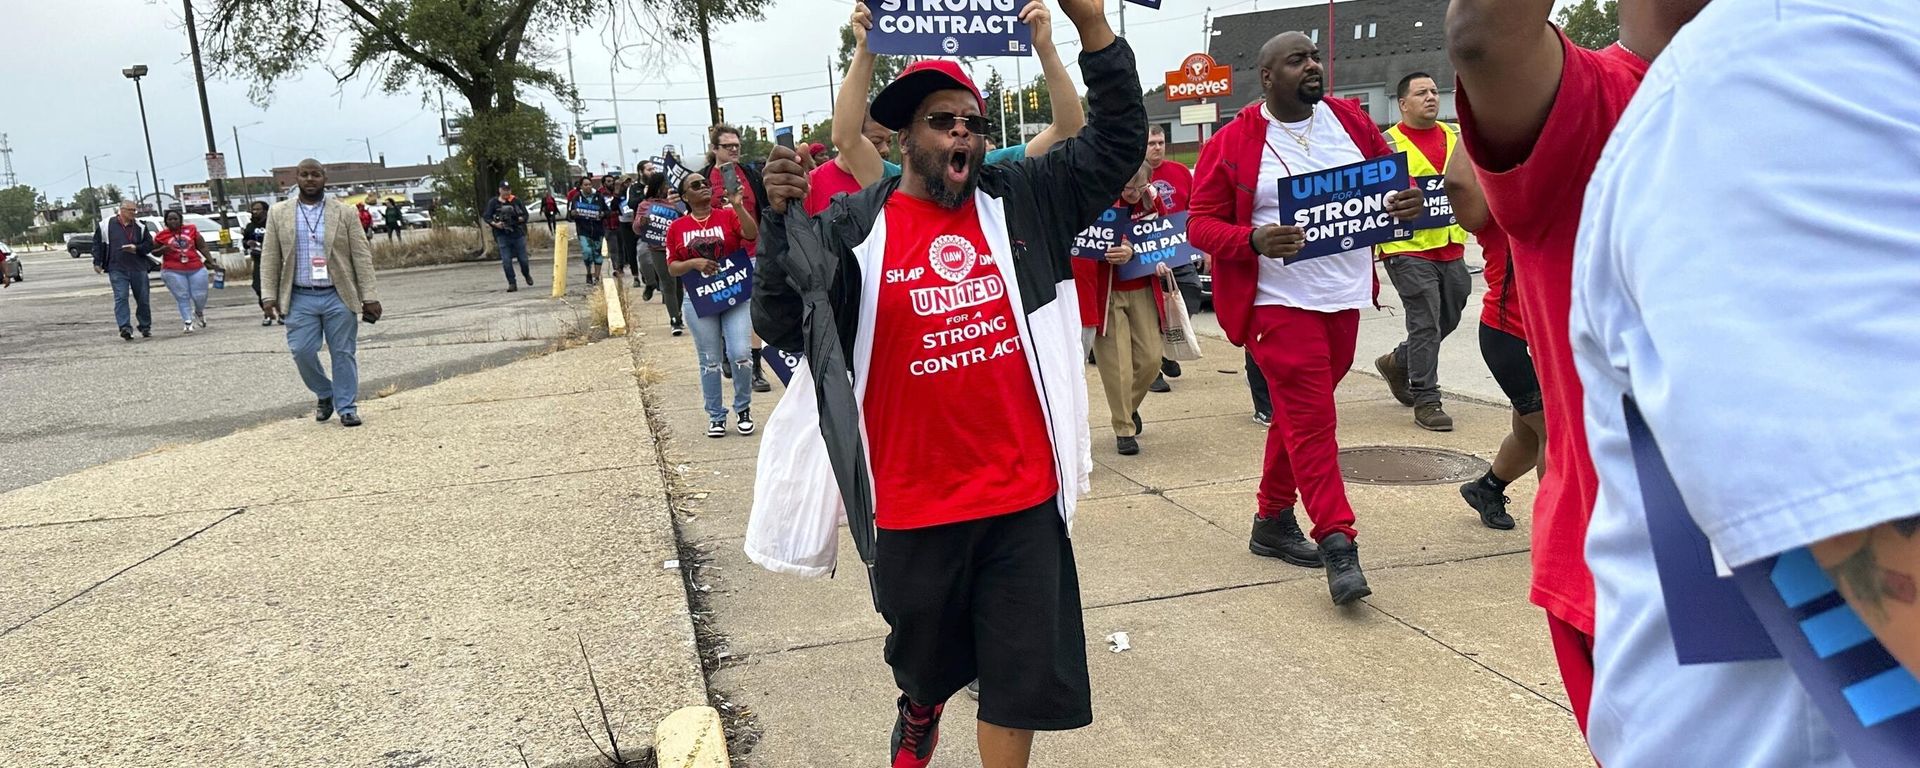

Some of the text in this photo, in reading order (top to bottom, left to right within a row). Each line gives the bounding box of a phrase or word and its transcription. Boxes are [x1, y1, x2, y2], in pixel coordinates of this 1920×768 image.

[879, 15, 1018, 34] CONTRACT
[1292, 159, 1397, 200] UNITED
[1332, 190, 1362, 201] FOR A
[682, 226, 725, 248] UNION
[1133, 218, 1173, 236] COLA
[1305, 214, 1400, 242] ONTRAC
[1073, 237, 1114, 250] RACT
[1134, 232, 1187, 254] AIR PAY
[943, 251, 962, 262] UAW
[1140, 246, 1176, 265] NOW
[696, 268, 748, 297] FAIR PAY
[886, 266, 925, 284] SHAP
[711, 282, 742, 303] NOW
[910, 274, 1004, 316] UNITED
[946, 311, 982, 325] FOR A
[922, 316, 1007, 349] STRONG
[910, 336, 1021, 376] CONTRACT
